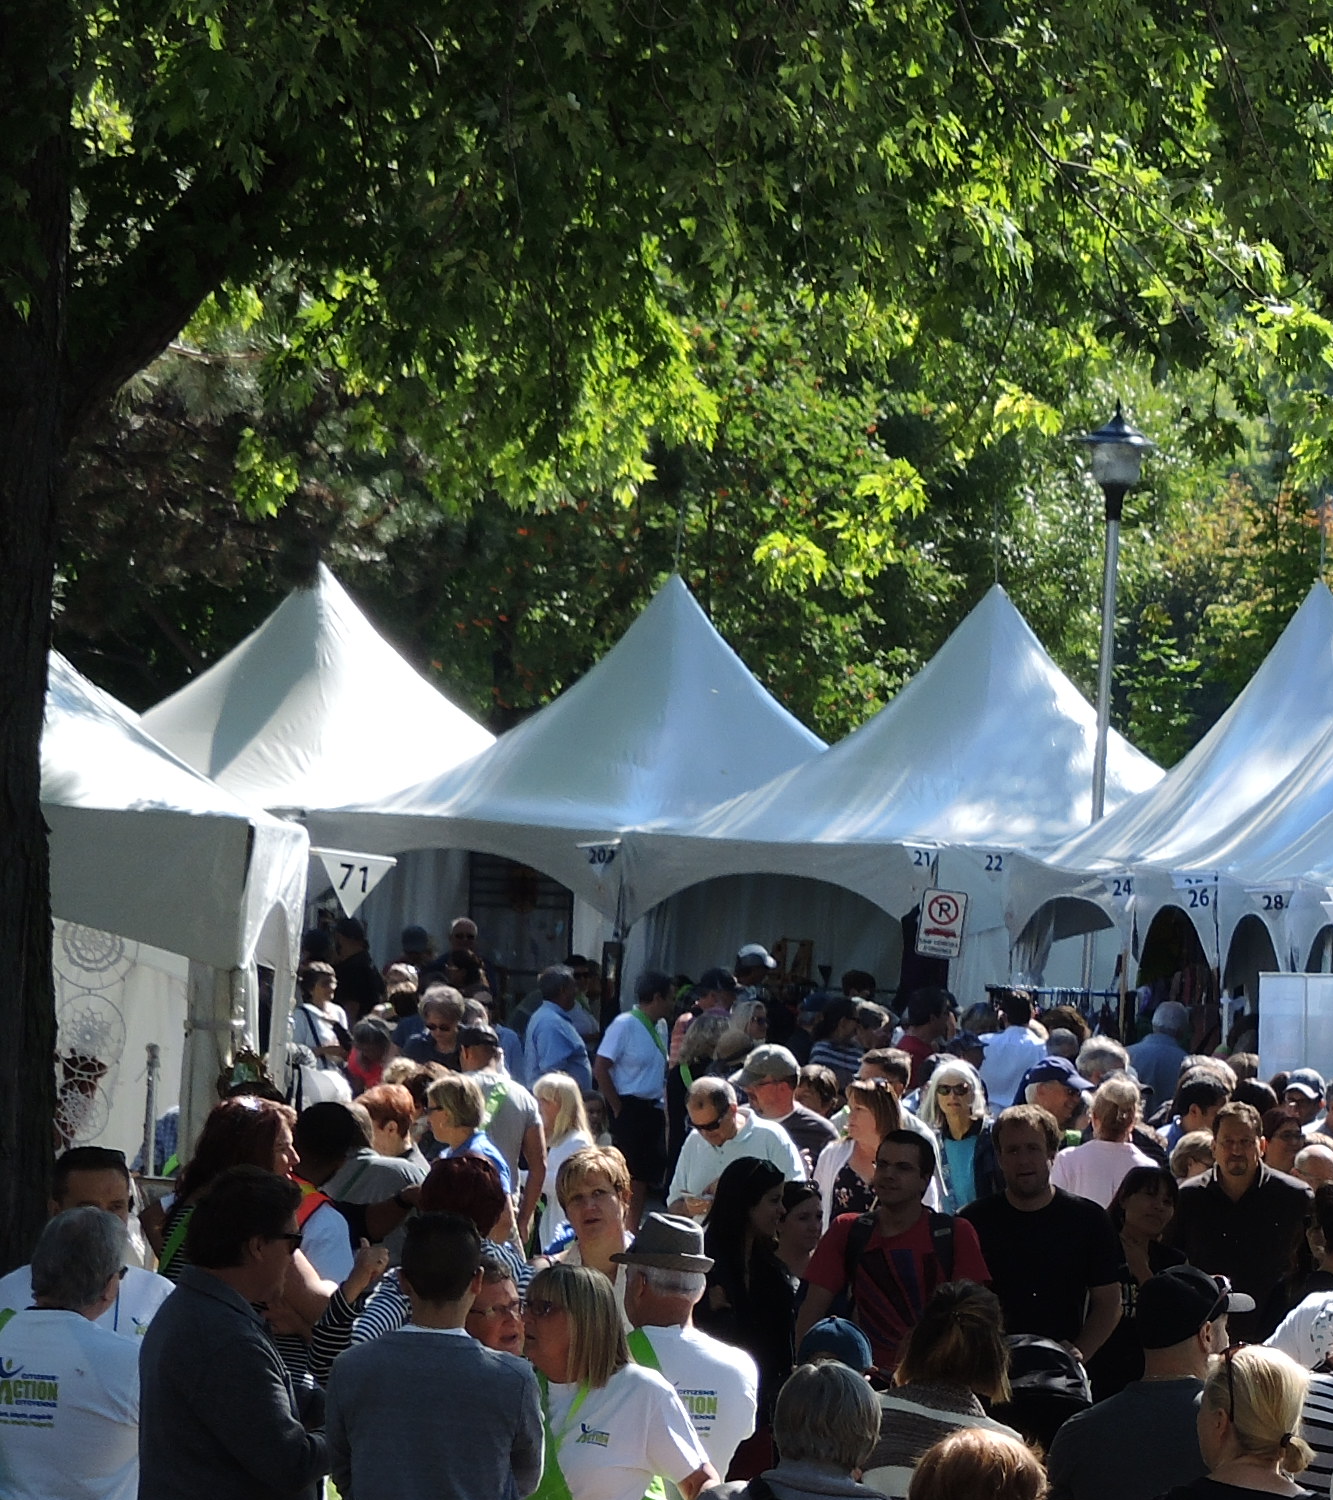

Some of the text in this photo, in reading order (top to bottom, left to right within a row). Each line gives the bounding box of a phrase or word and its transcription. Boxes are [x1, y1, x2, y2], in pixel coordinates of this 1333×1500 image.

[913, 850, 930, 867] 21
[985, 854, 1003, 872] 22
[339, 863, 368, 893] 71
[1112, 879, 1132, 897] 24
[1188, 887, 1210, 908] 26
[1262, 895, 1285, 911] 28
